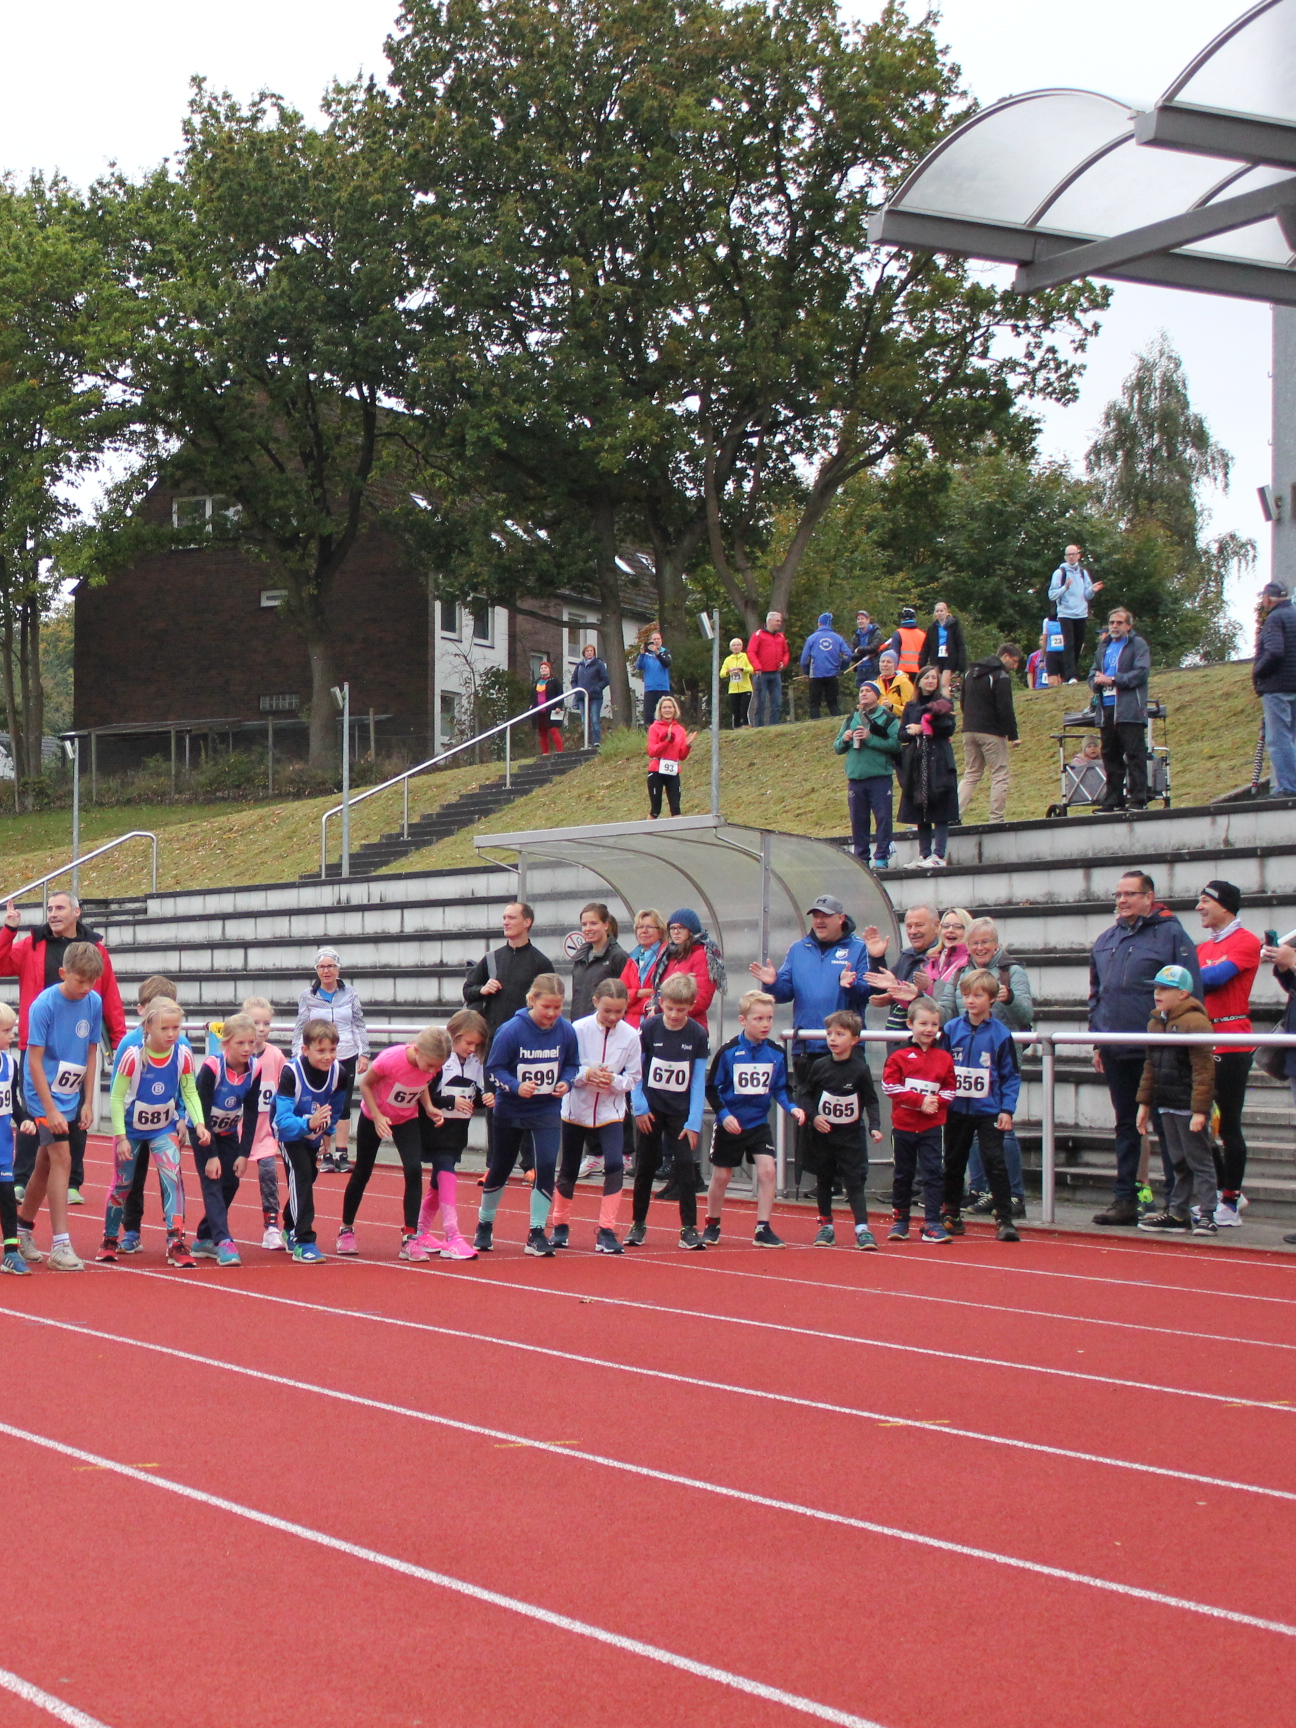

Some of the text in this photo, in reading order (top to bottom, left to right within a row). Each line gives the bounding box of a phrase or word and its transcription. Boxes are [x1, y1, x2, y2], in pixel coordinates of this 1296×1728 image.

[664, 763, 674, 772] 93
[519, 1045, 560, 1059] hummel
[521, 1068, 555, 1087] 699
[653, 1066, 686, 1086] 670
[737, 1071, 770, 1088] 662
[955, 1073, 985, 1092] 656
[137, 1108, 170, 1125] 681
[822, 1100, 855, 1118] 665
